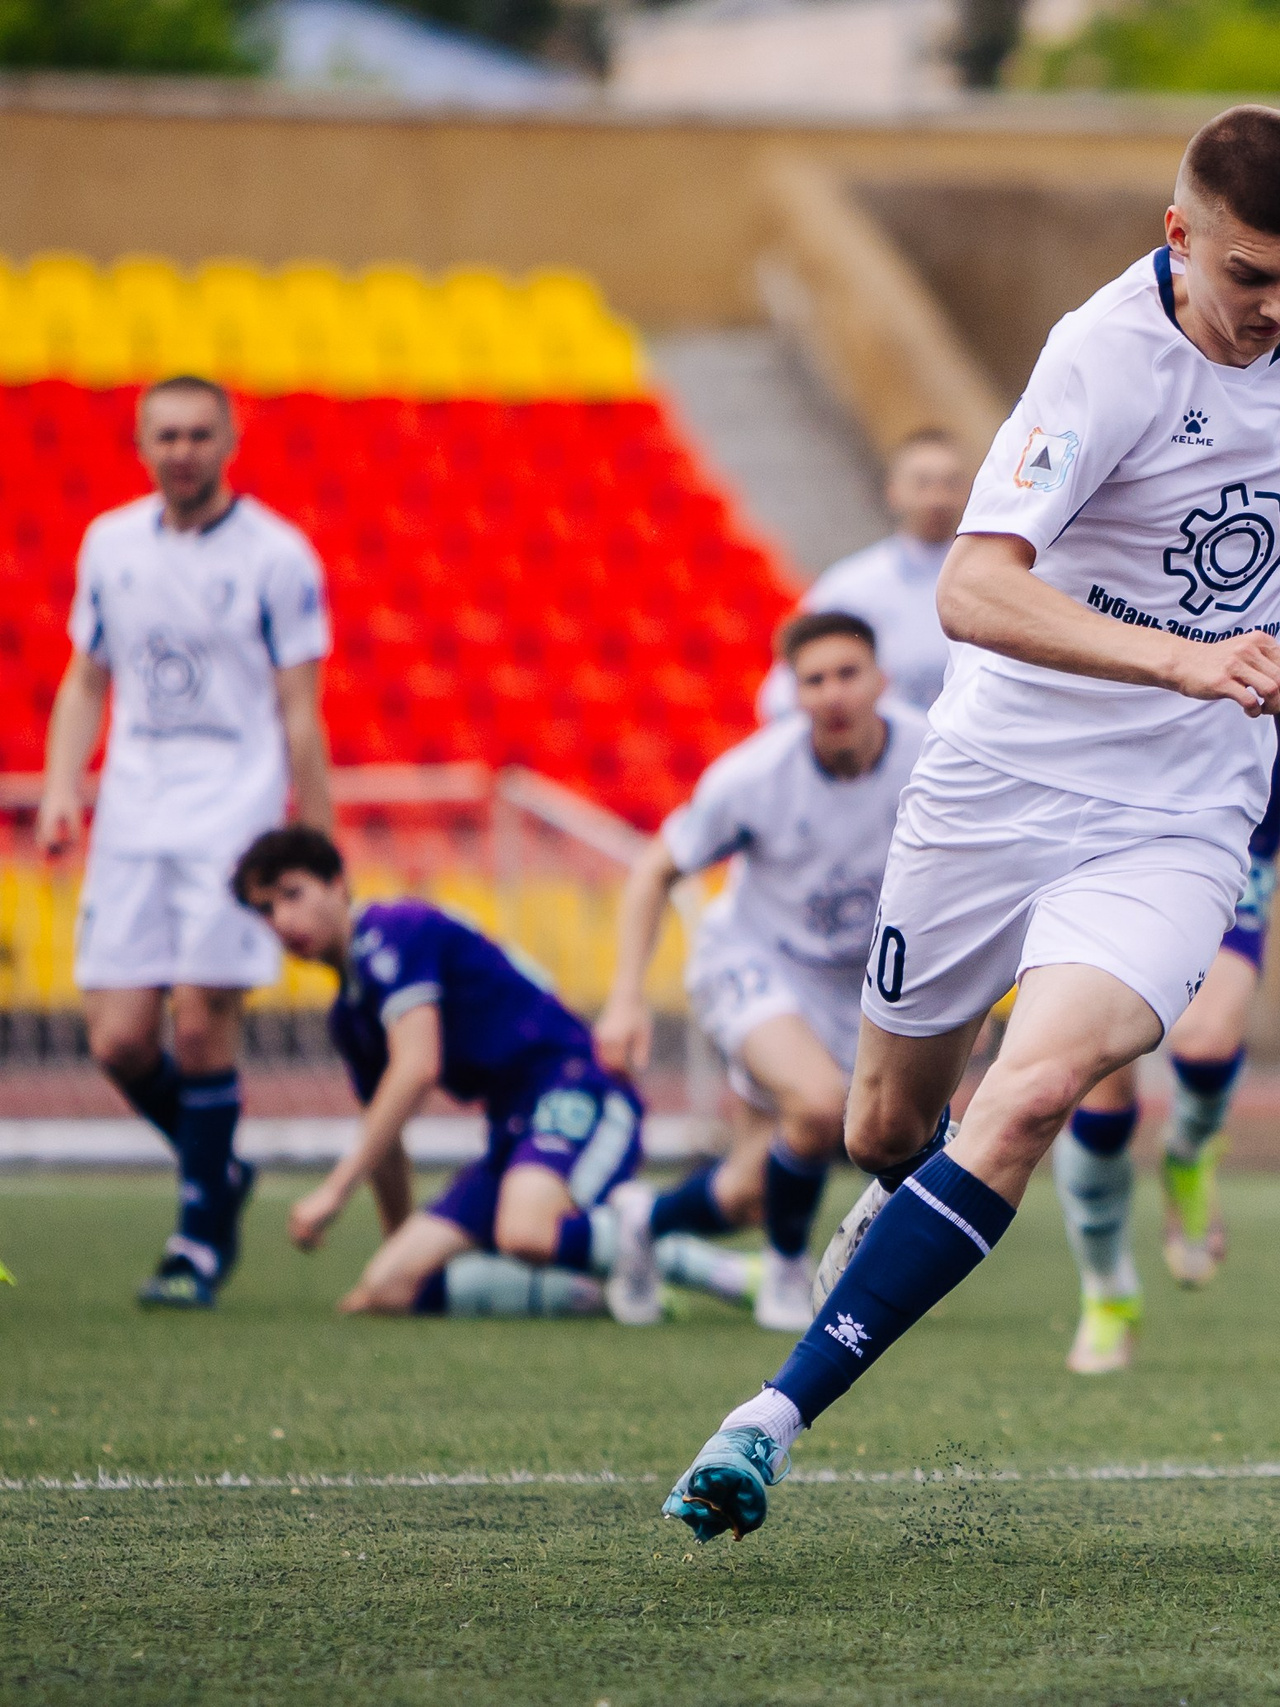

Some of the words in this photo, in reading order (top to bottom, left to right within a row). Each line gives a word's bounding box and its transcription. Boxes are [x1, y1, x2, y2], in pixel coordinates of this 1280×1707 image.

[1170, 435, 1214, 447] KELME
[866, 904, 906, 1003] 0
[823, 1323, 864, 1359] KELME
